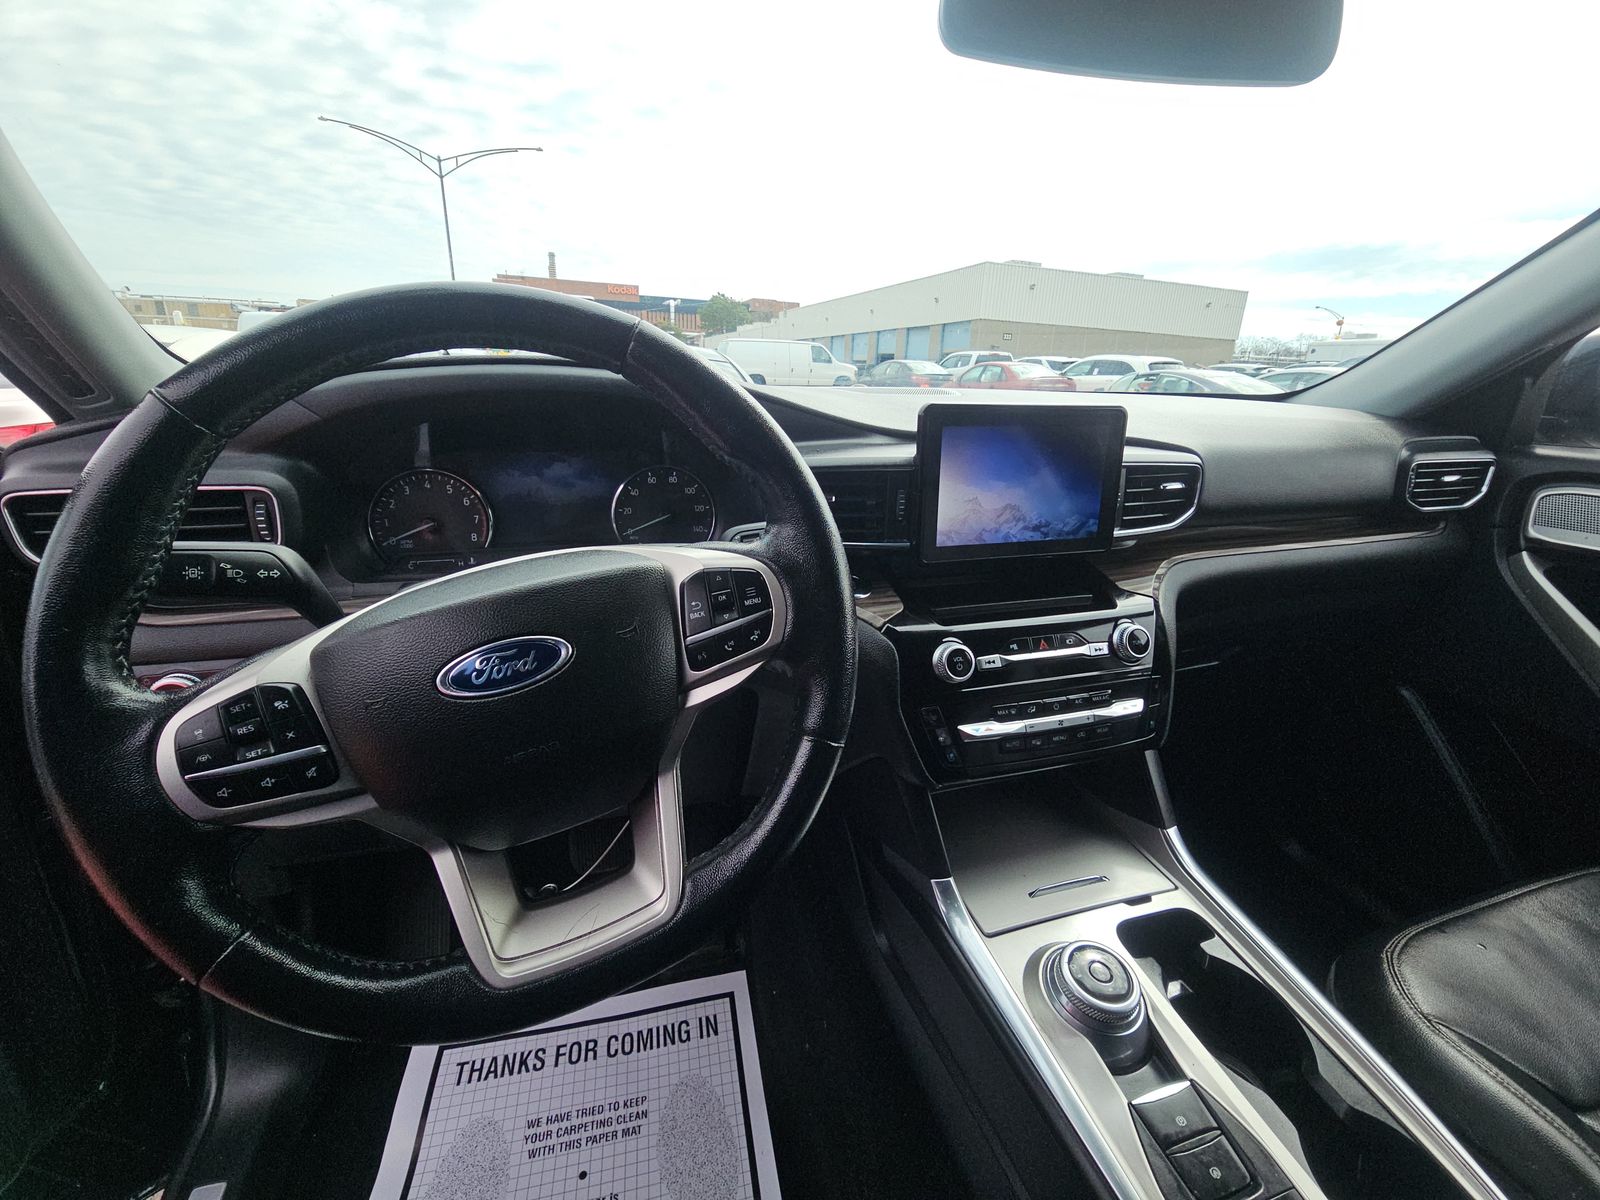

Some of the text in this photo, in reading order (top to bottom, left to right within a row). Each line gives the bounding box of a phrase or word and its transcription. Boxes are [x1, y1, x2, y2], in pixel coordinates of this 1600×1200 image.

[607, 284, 638, 295] Kodak
[424, 480, 431, 488] 4
[668, 476, 678, 484] 80
[403, 486, 410, 495] 3
[446, 485, 453, 494] 5
[630, 488, 639, 496] 40
[389, 500, 396, 509] 2
[463, 497, 470, 506] 6
[623, 507, 632, 515] 20
[473, 515, 479, 524] 7
[471, 533, 478, 542] 8
[744, 597, 762, 606] MENU
[689, 611, 706, 620] BACK
[471, 648, 538, 685] Ford
[236, 724, 255, 736] RES
[455, 1013, 719, 1086] THANKS FOR COMING IN
[526, 1095, 648, 1130] WE HAVE TRIED TO KEEP
[523, 1109, 648, 1145] YOUR CARPETING CLEAN
[527, 1124, 644, 1160] WITH THIS PAPER MAT
